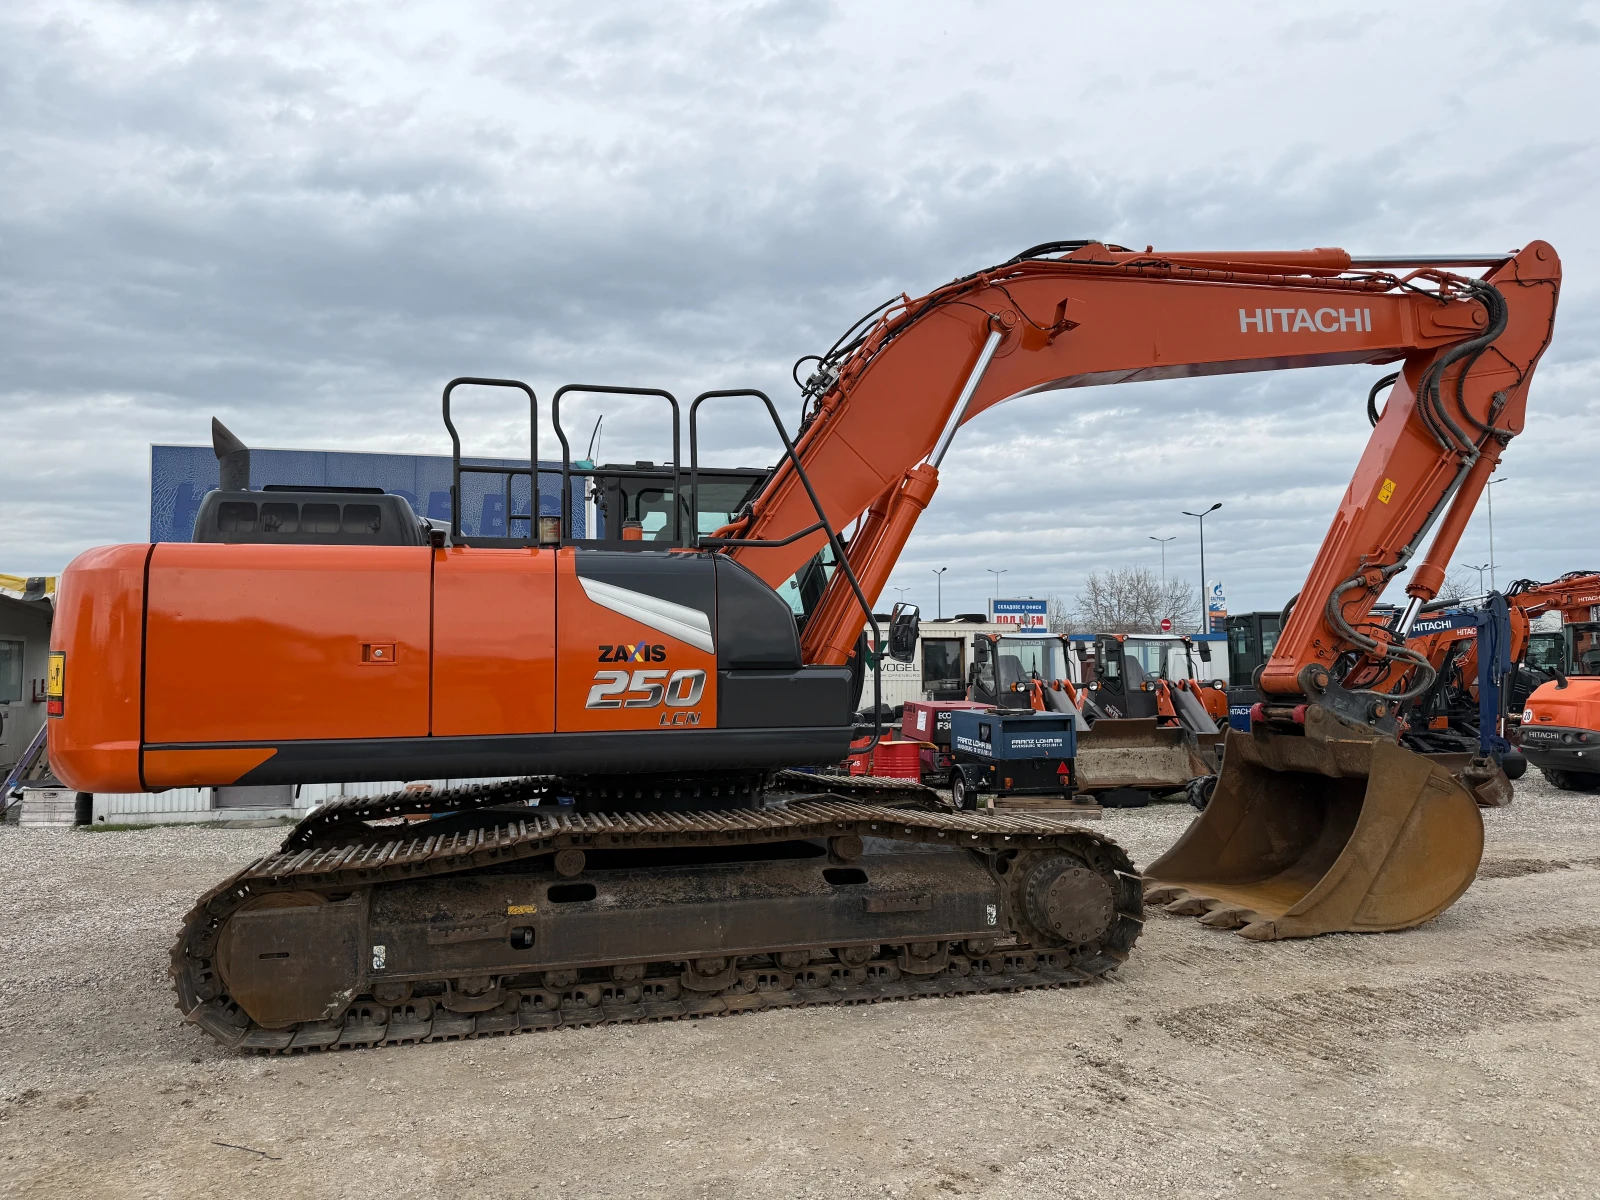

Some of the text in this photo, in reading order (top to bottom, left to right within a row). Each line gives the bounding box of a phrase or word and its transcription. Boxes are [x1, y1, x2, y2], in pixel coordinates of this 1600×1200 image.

[1238, 307, 1372, 333] HITACHI
[1019, 616, 1044, 625] НЕМ
[1412, 620, 1452, 632] HITACHI
[1456, 627, 1477, 636] HITAC
[598, 641, 666, 662] ZAXIS
[880, 663, 920, 672] VOGEL
[584, 668, 707, 709] 250
[658, 711, 702, 726] LCN
[1528, 731, 1559, 739] HITACHI
